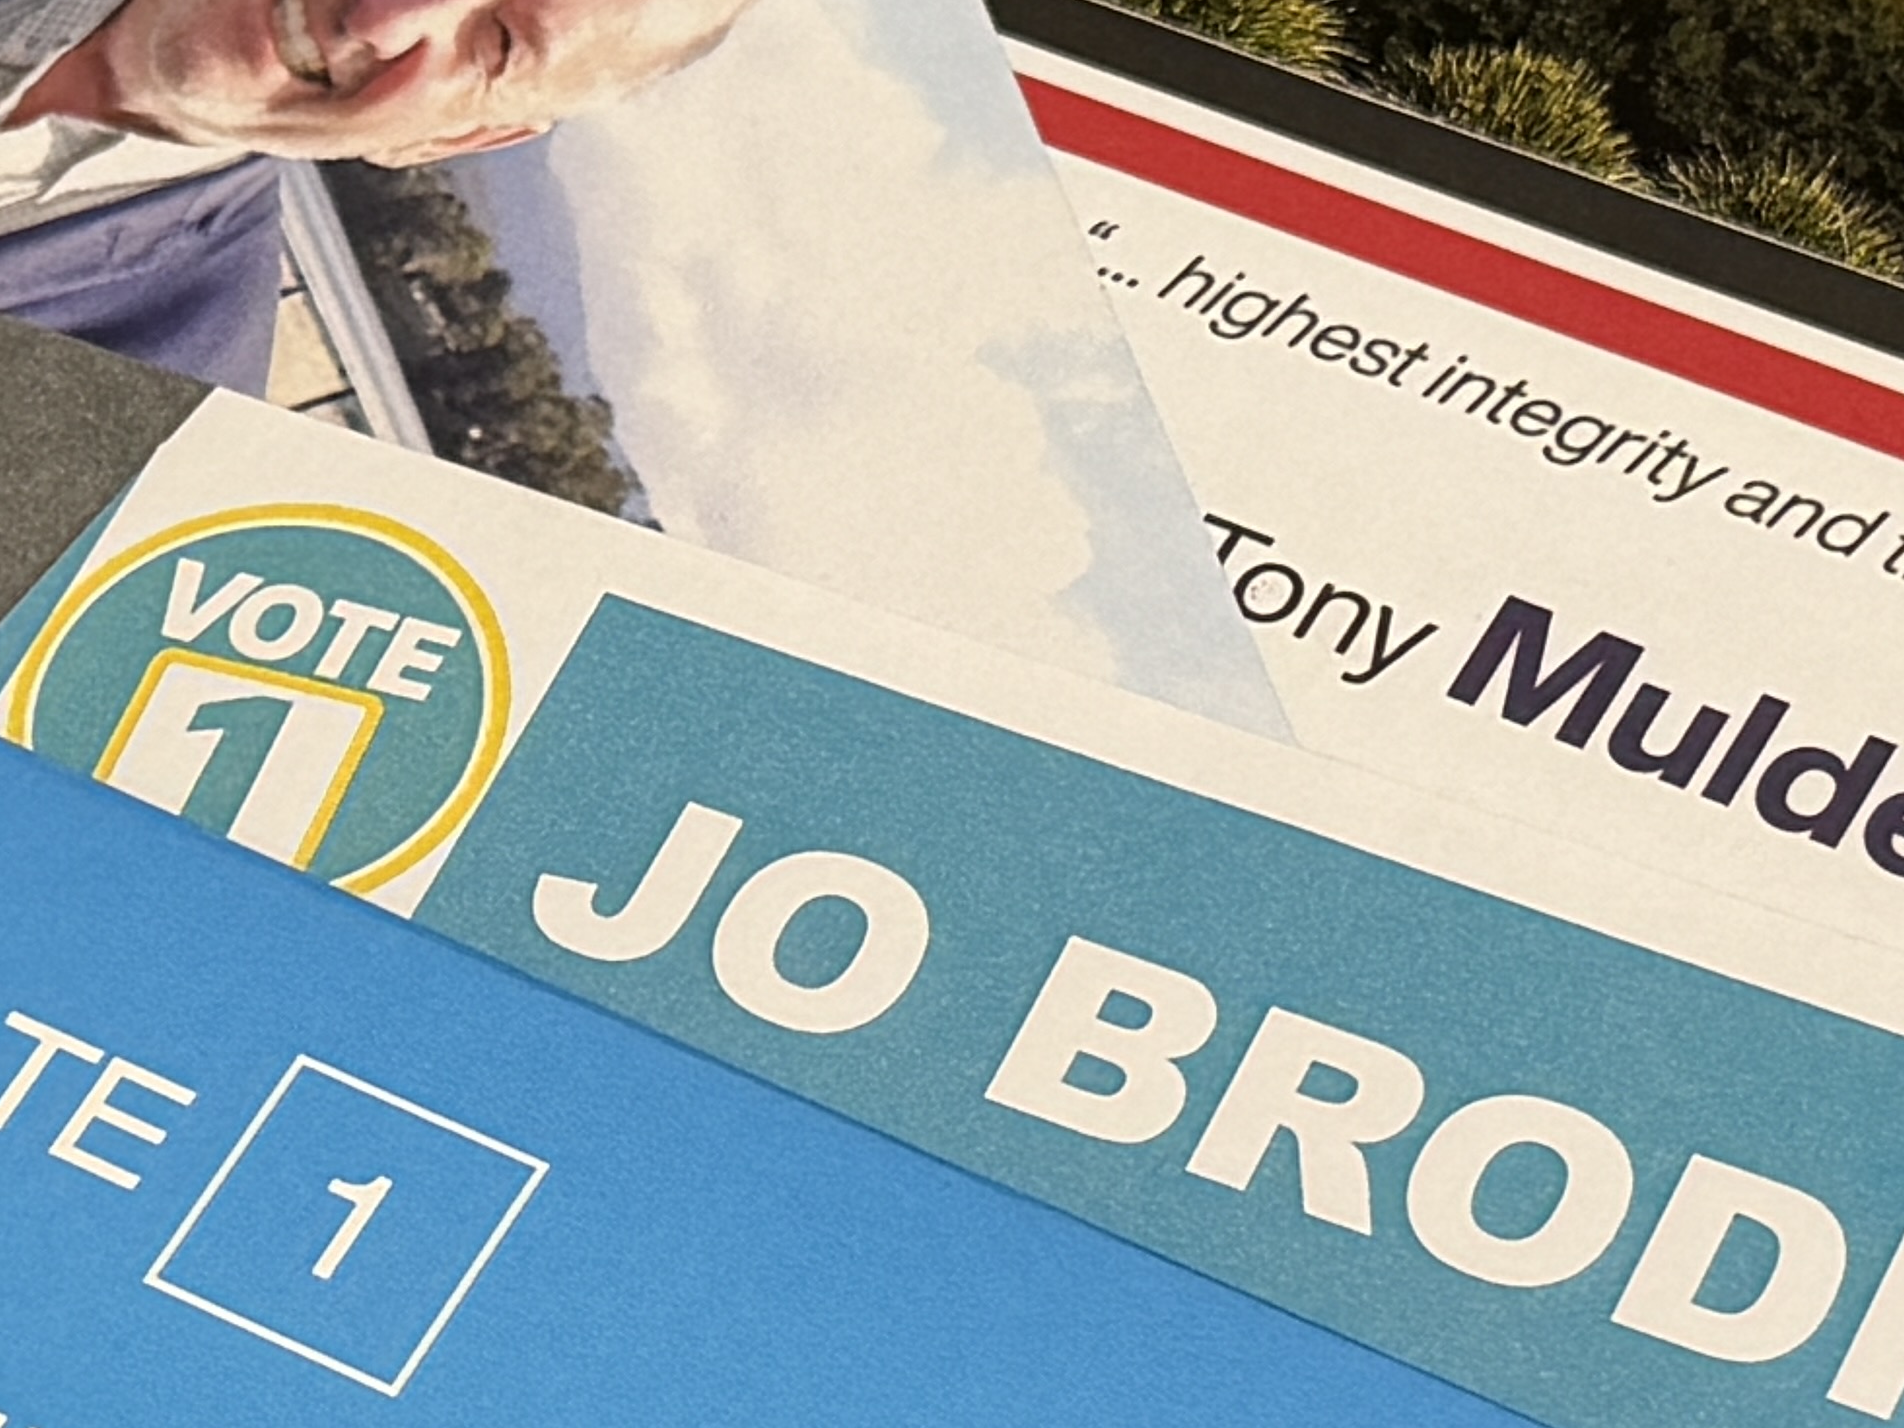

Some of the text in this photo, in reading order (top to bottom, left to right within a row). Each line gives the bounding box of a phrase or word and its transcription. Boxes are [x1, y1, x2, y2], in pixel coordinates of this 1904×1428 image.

[1157, 254, 1430, 388] highest
[1422, 354, 1730, 504] integrity
[1724, 472, 1891, 558] and
[159, 556, 462, 703] VOTE
[1202, 512, 1439, 686] Tony
[184, 694, 296, 838] 1
[532, 800, 930, 1035] JO
[310, 1174, 395, 1281] 1
